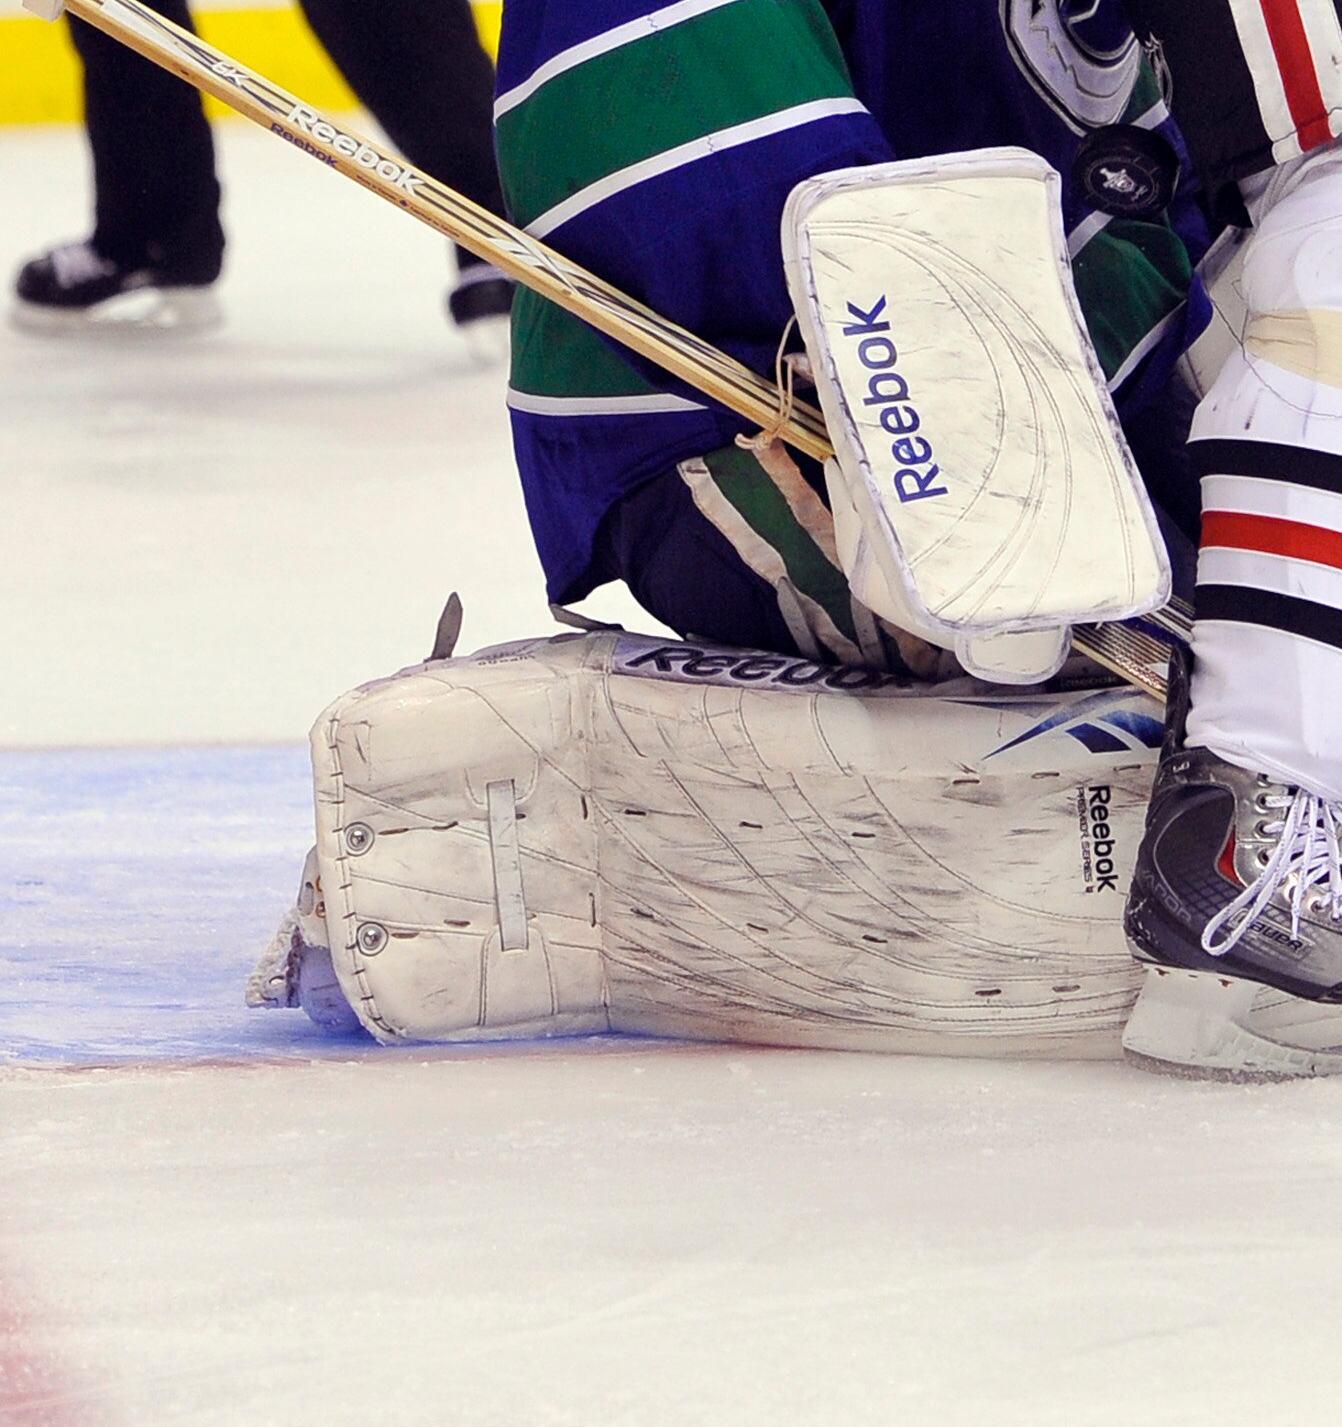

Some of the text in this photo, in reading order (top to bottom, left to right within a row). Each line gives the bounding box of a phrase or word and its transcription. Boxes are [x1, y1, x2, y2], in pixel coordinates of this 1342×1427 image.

[269, 122, 339, 169] Reebok
[286, 103, 425, 197] Reebok
[842, 294, 949, 503] Reebok
[1088, 785, 1119, 893] Reebok
